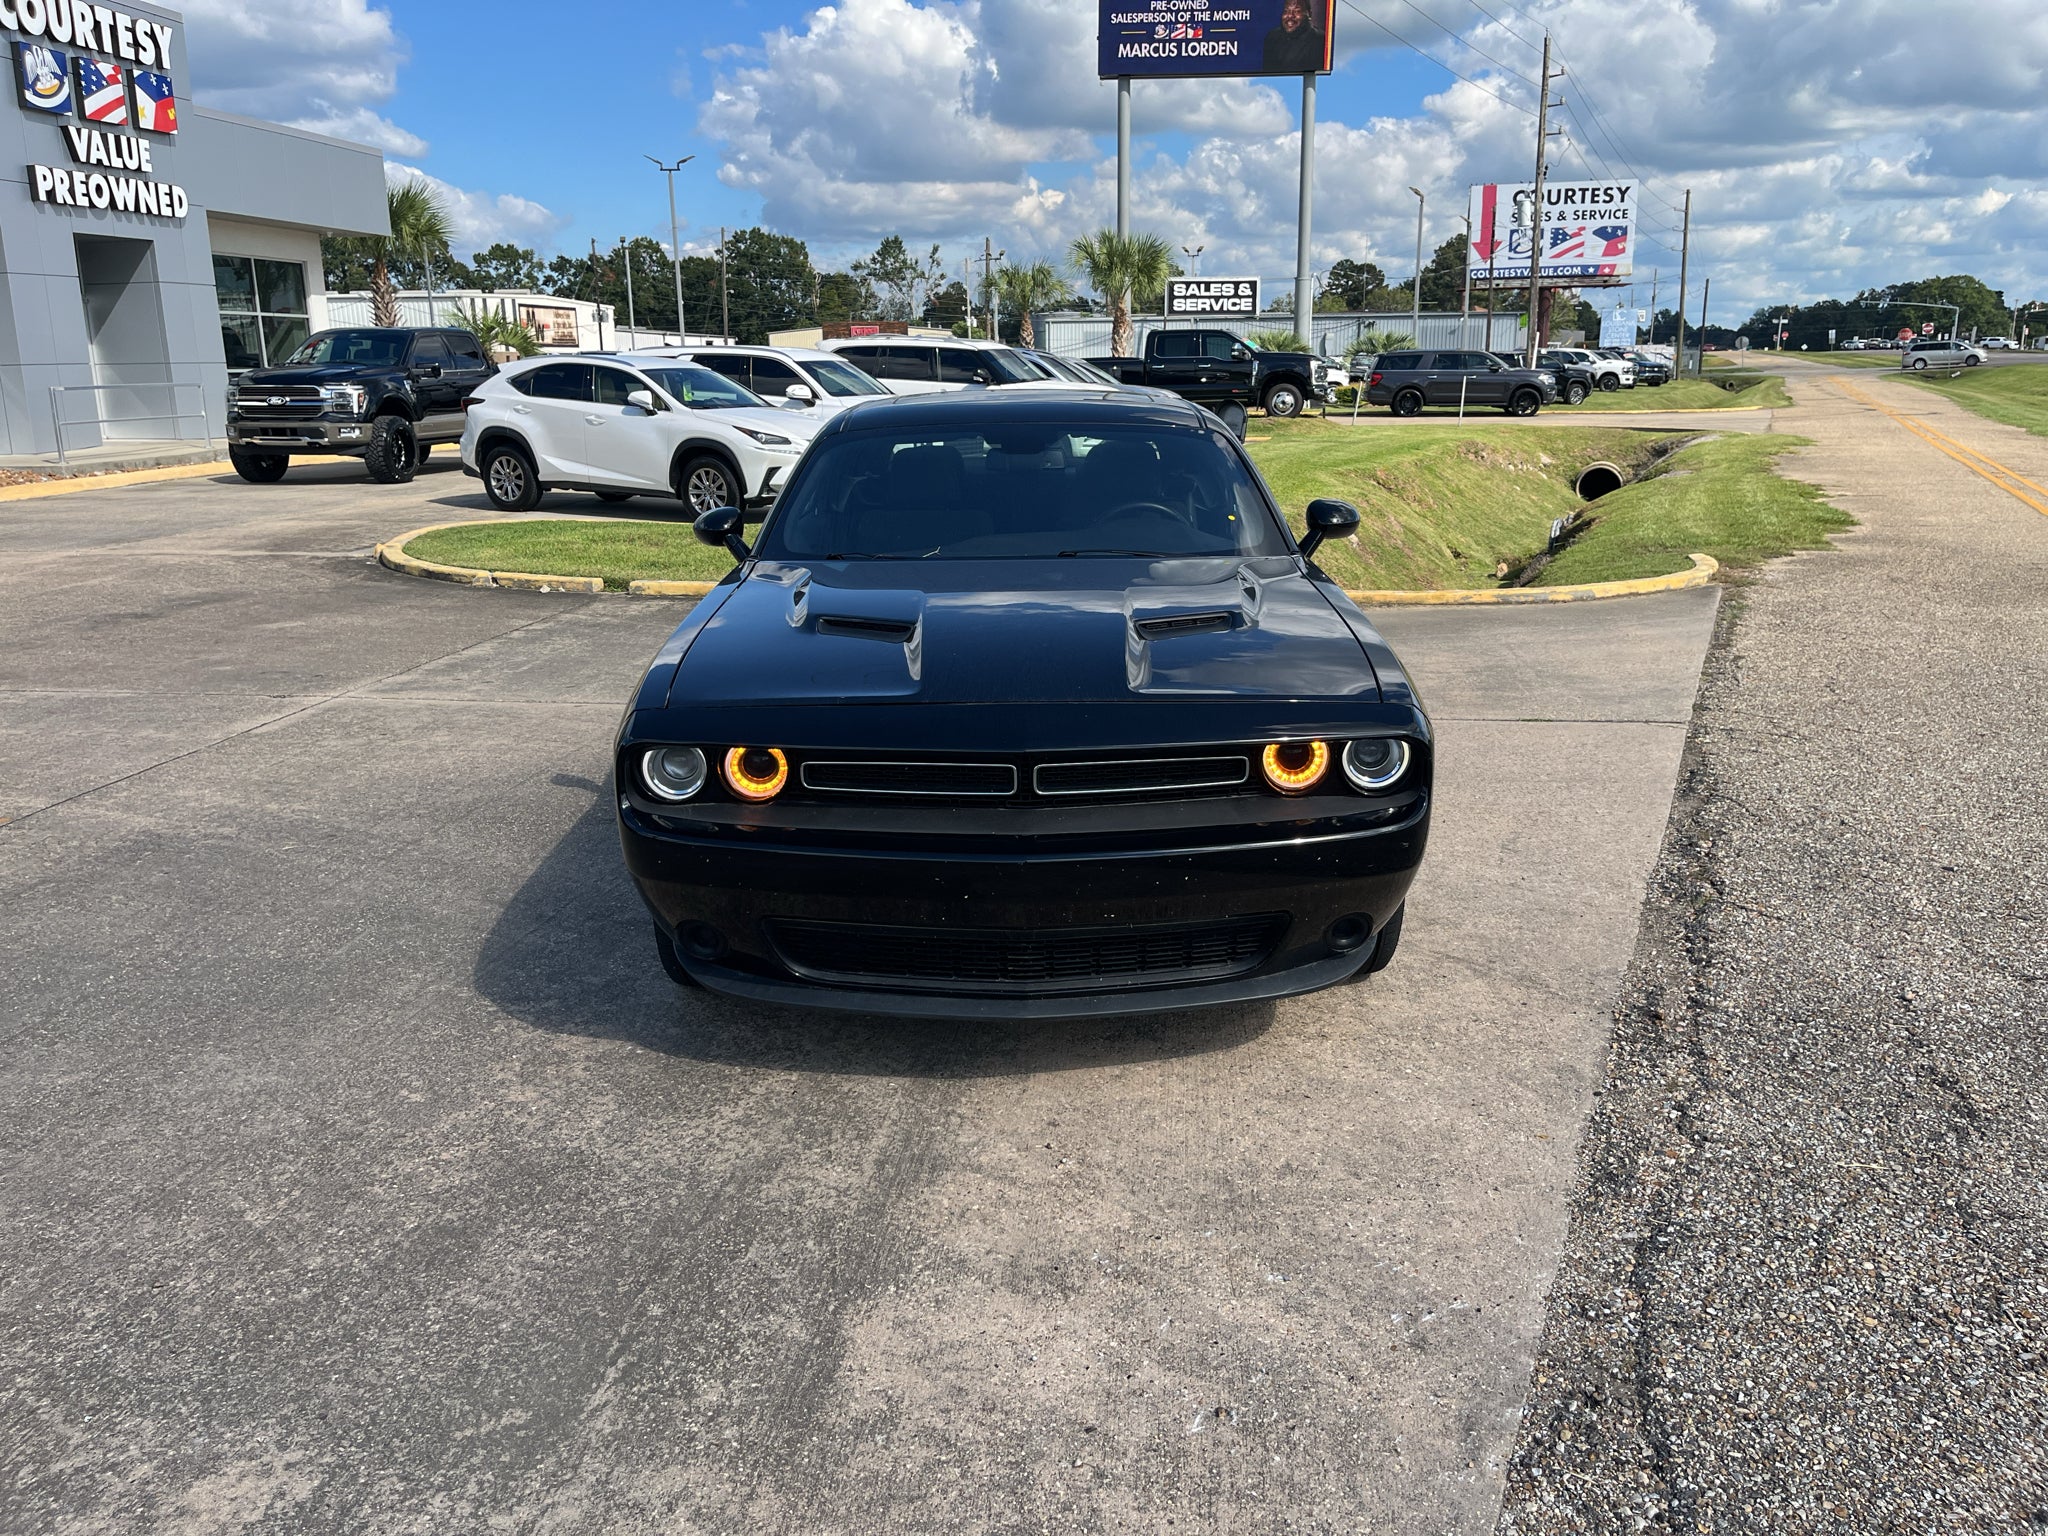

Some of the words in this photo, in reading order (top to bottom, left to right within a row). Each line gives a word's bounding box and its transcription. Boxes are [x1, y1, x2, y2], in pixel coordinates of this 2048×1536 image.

[1150, 0, 1208, 10] PRE-OWNED
[1111, 12, 1178, 24] SALESPERSON
[1179, 12, 1192, 23] OF
[1193, 11, 1211, 22] THE
[1213, 10, 1250, 21] MONTH
[0, 0, 173, 69] COURTESY
[1118, 42, 1178, 58] MARCUS
[1182, 41, 1238, 56] LORDEN
[68, 125, 153, 173] VALUE
[34, 164, 189, 219] PREOWNED
[1557, 210, 1567, 221] &
[1573, 208, 1629, 221] SERVICE
[1173, 283, 1234, 296] SALES
[1238, 283, 1252, 296] &
[1172, 297, 1253, 311] SERVICE
